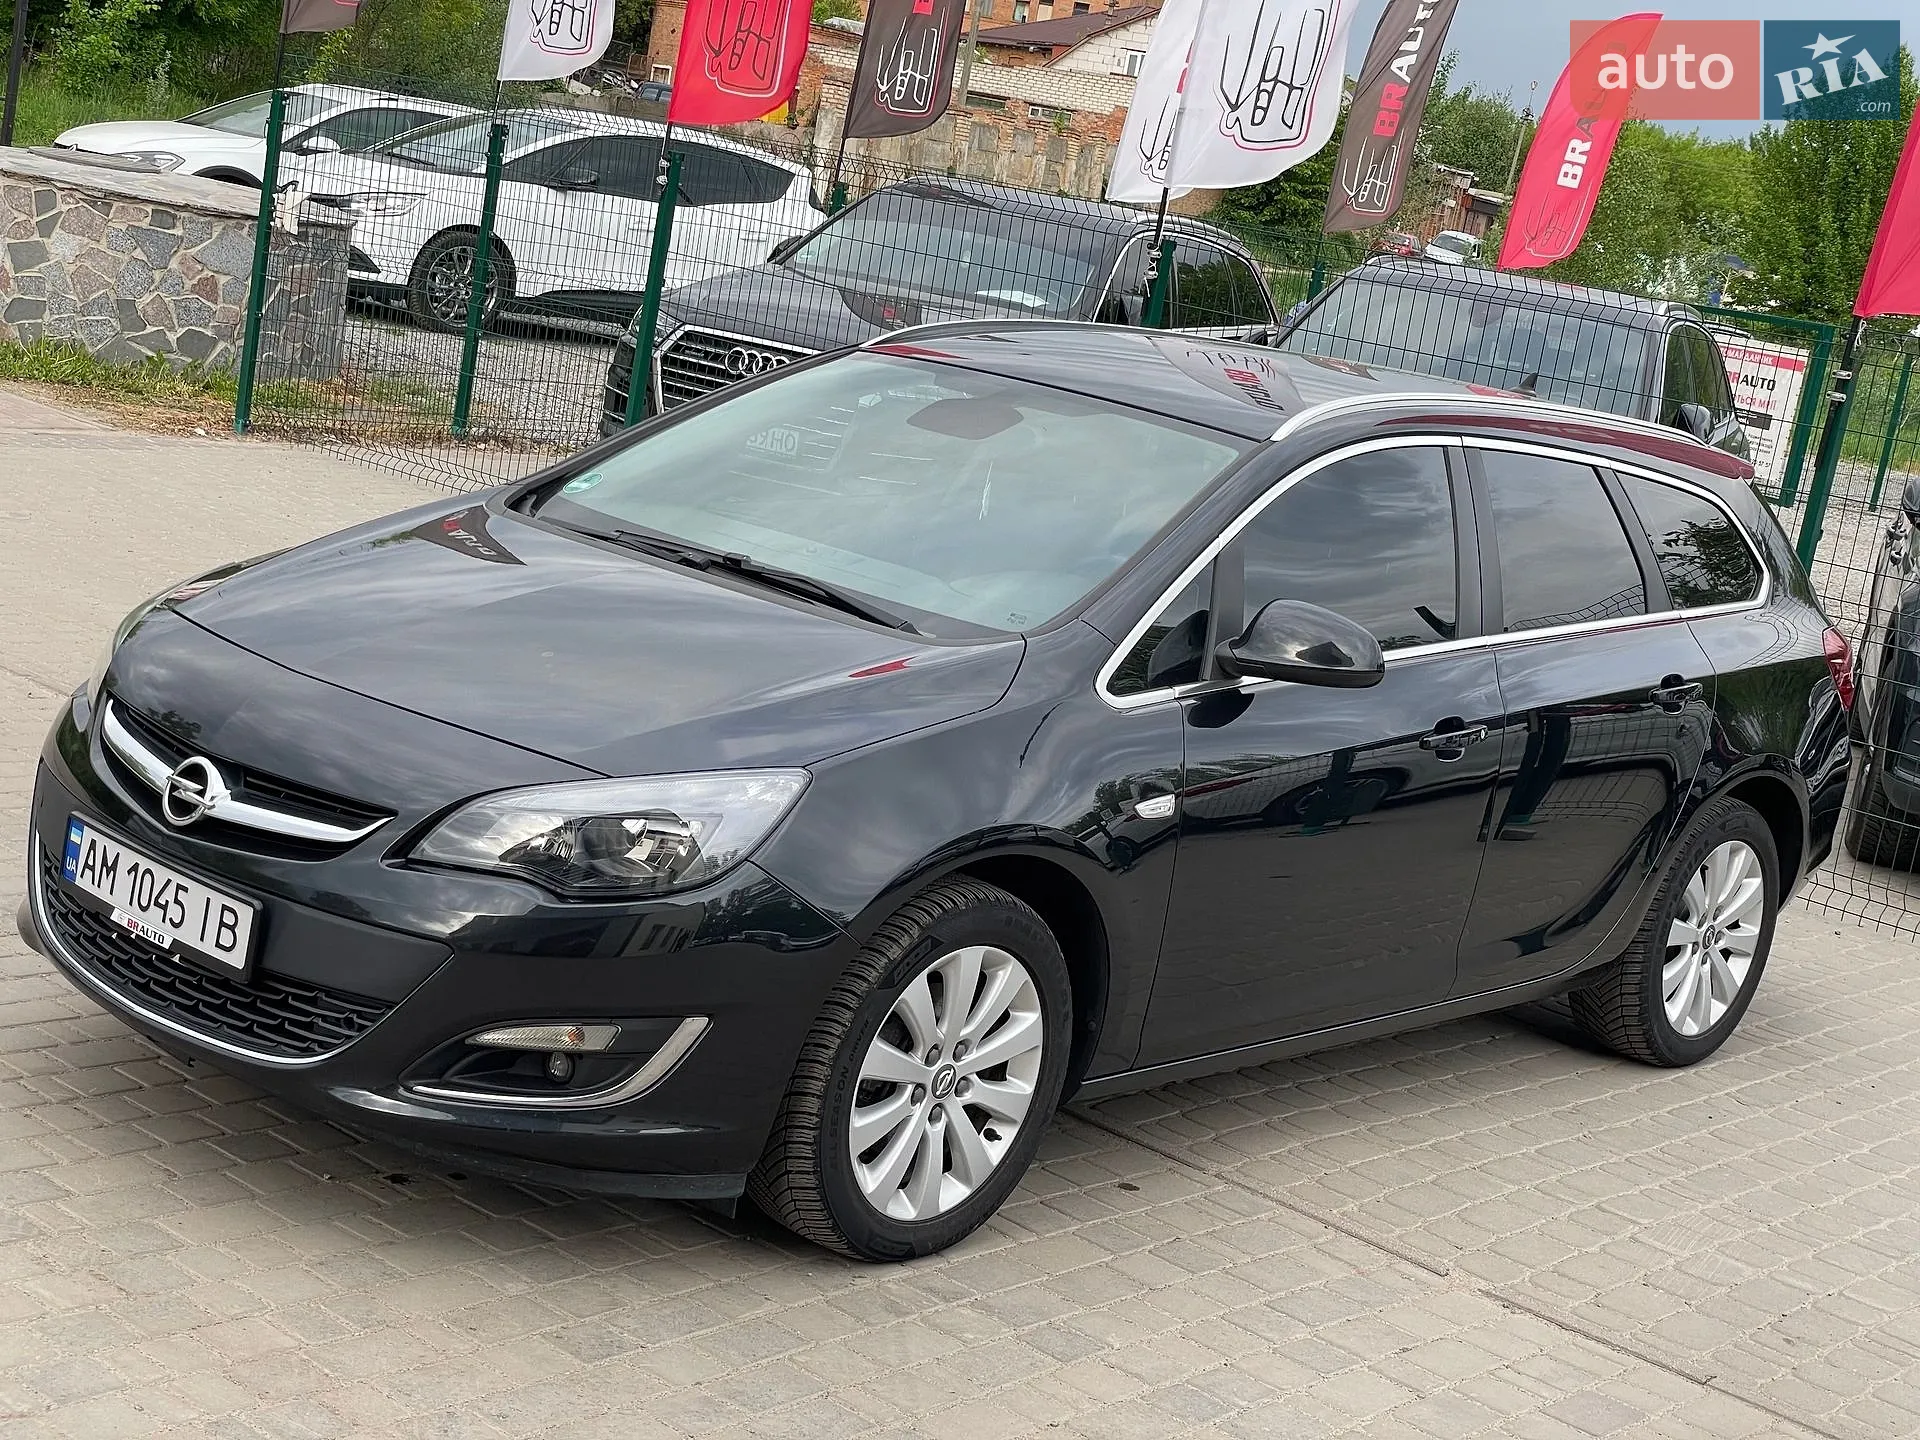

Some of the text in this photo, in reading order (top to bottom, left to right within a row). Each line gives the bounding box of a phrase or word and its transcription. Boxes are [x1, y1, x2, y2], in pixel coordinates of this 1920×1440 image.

[1373, 0, 1440, 137] BRAUT
[66, 857, 77, 874] UA
[80, 838, 239, 953] AM 1045 IB
[126, 918, 165, 945] BRAUTO
